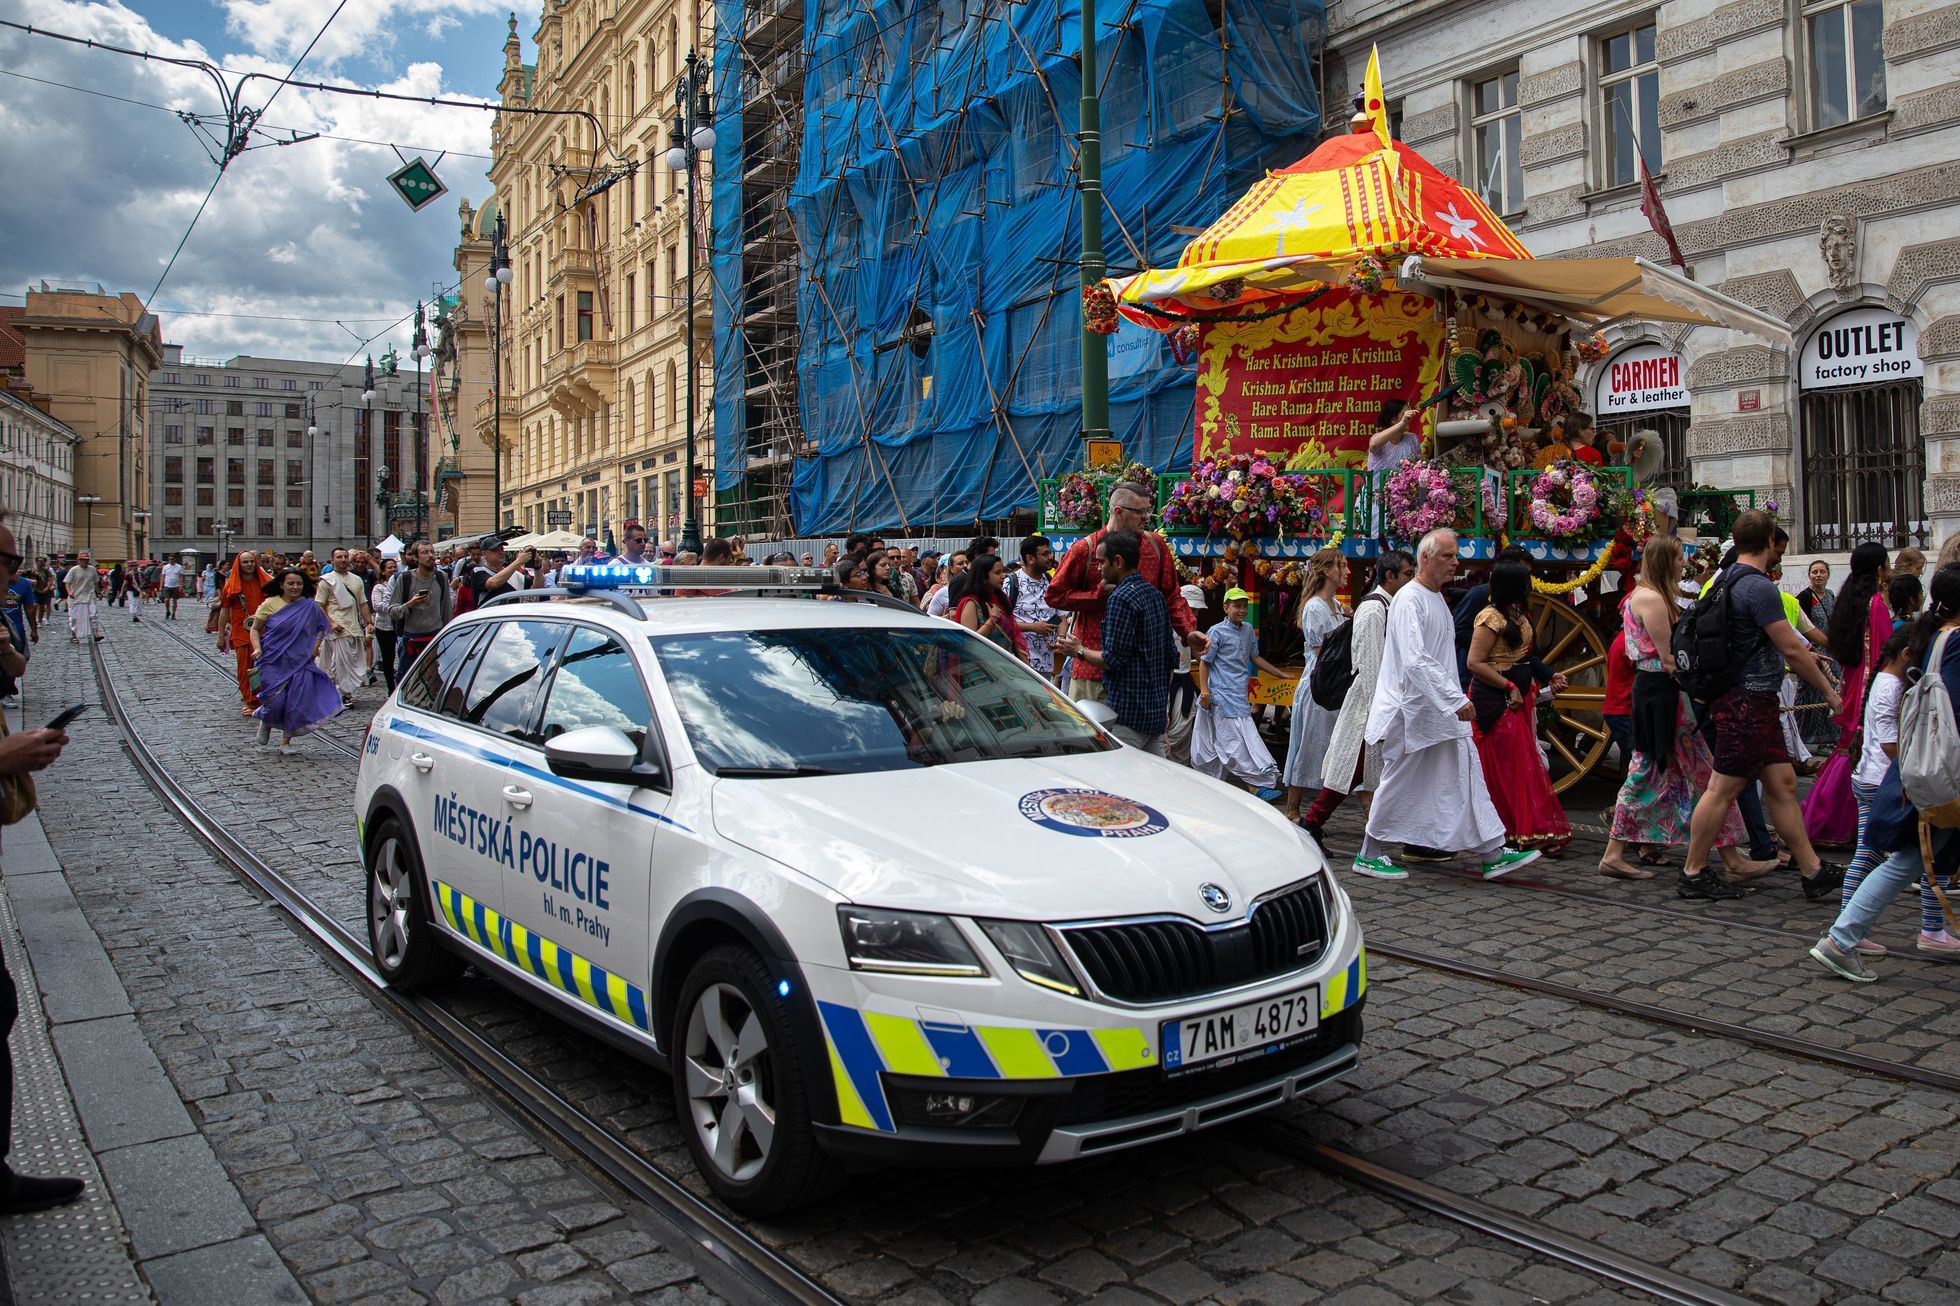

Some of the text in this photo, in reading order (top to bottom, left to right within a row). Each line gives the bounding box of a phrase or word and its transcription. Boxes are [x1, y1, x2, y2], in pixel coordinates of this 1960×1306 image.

[1818, 321, 1906, 360] OUTLET
[1245, 347, 1402, 371] Hare Krishna Hare Krishna
[1815, 358, 1911, 380] factory shop
[1241, 374, 1402, 396] Krishna Krishna Hare Hare
[1611, 356, 1679, 393] CARMEN
[1251, 397, 1381, 417] Hare Rama Hare Rama
[1608, 388, 1684, 406] Fur & leather
[1250, 423, 1280, 439] Rama
[1283, 421, 1315, 438] Rama
[1318, 420, 1346, 437] Hare
[1101, 824, 1166, 838] PRAHA
[434, 792, 610, 911] MĚSTSKÁ POLICIE
[544, 892, 610, 947] hl. m. Prahy
[1186, 996, 1308, 1058] 7AM 4873
[1166, 1051, 1180, 1062] CZ
